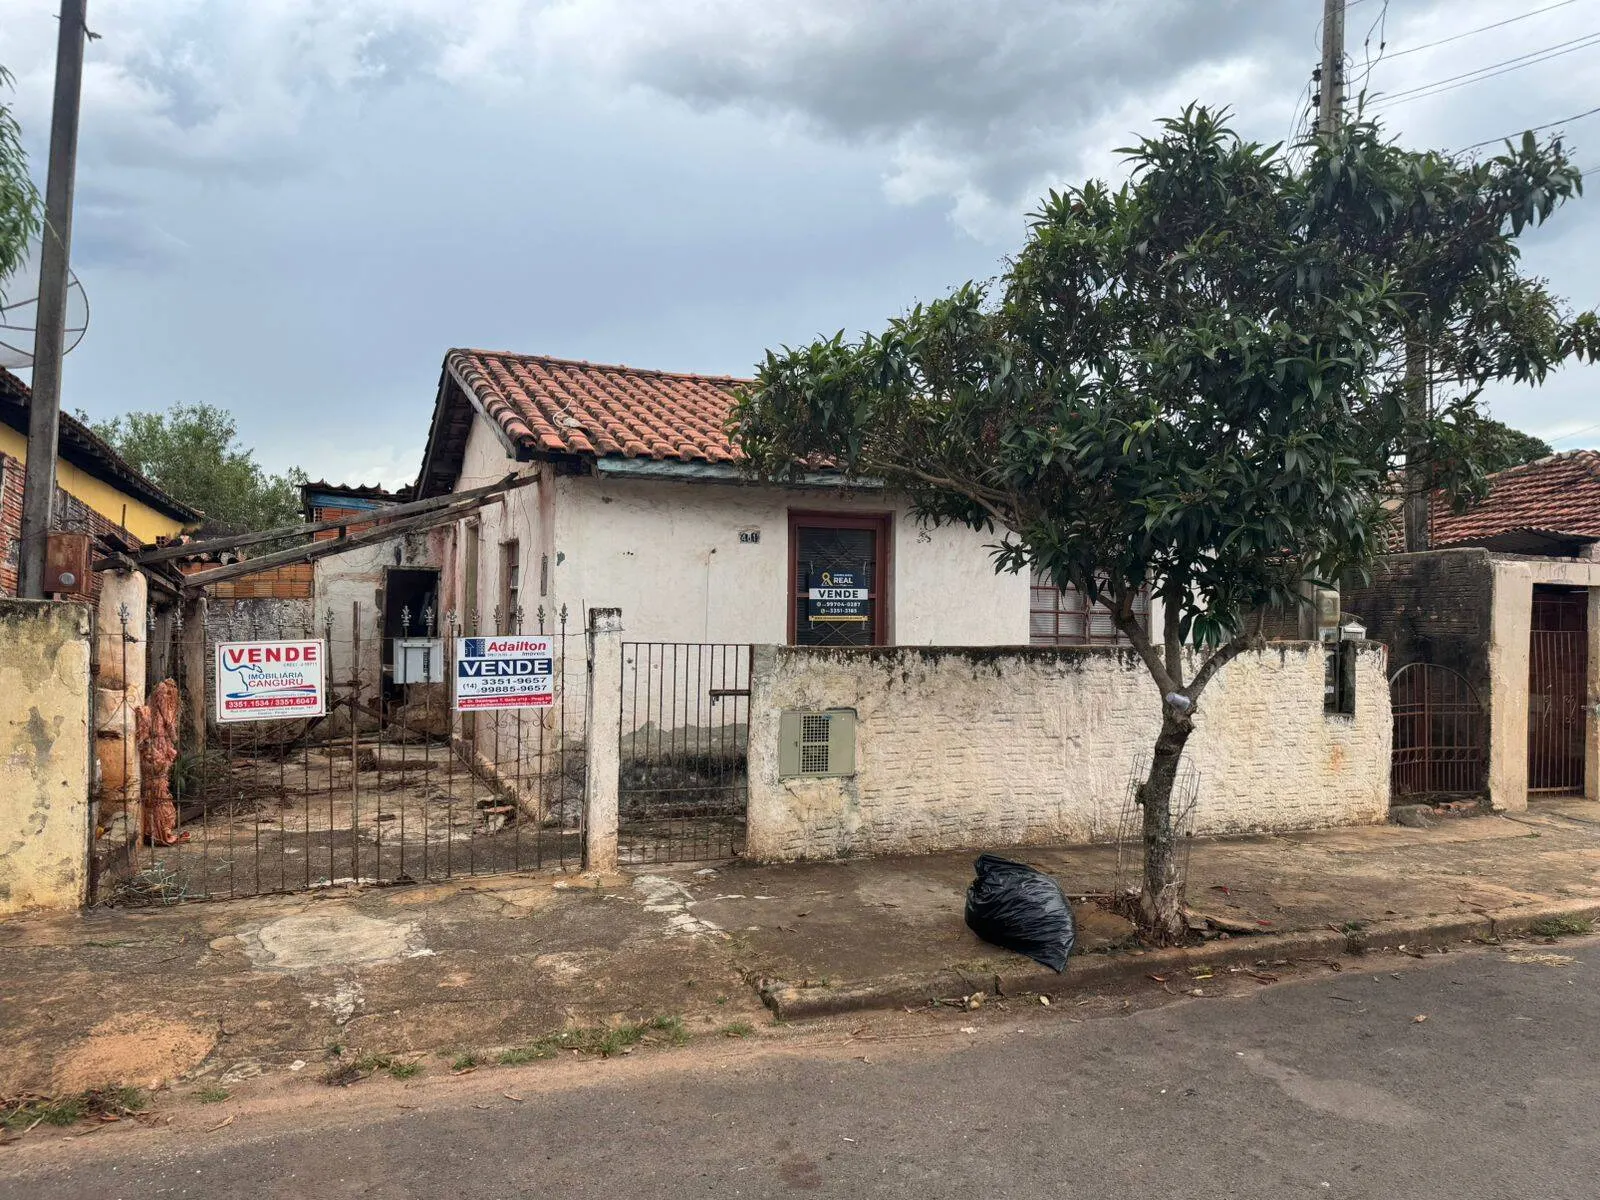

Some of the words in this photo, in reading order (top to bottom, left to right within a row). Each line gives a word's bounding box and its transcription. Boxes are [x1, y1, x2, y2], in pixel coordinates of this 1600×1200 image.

[818, 590, 859, 598] VENDE
[487, 642, 547, 652] Adailton
[228, 647, 317, 664] VENDE
[462, 660, 549, 676] VENDE
[248, 679, 303, 688] CANGURU
[481, 685, 547, 693] 99885-9657
[228, 700, 270, 708] 3351.1534
[274, 698, 315, 706] 3351.6047
